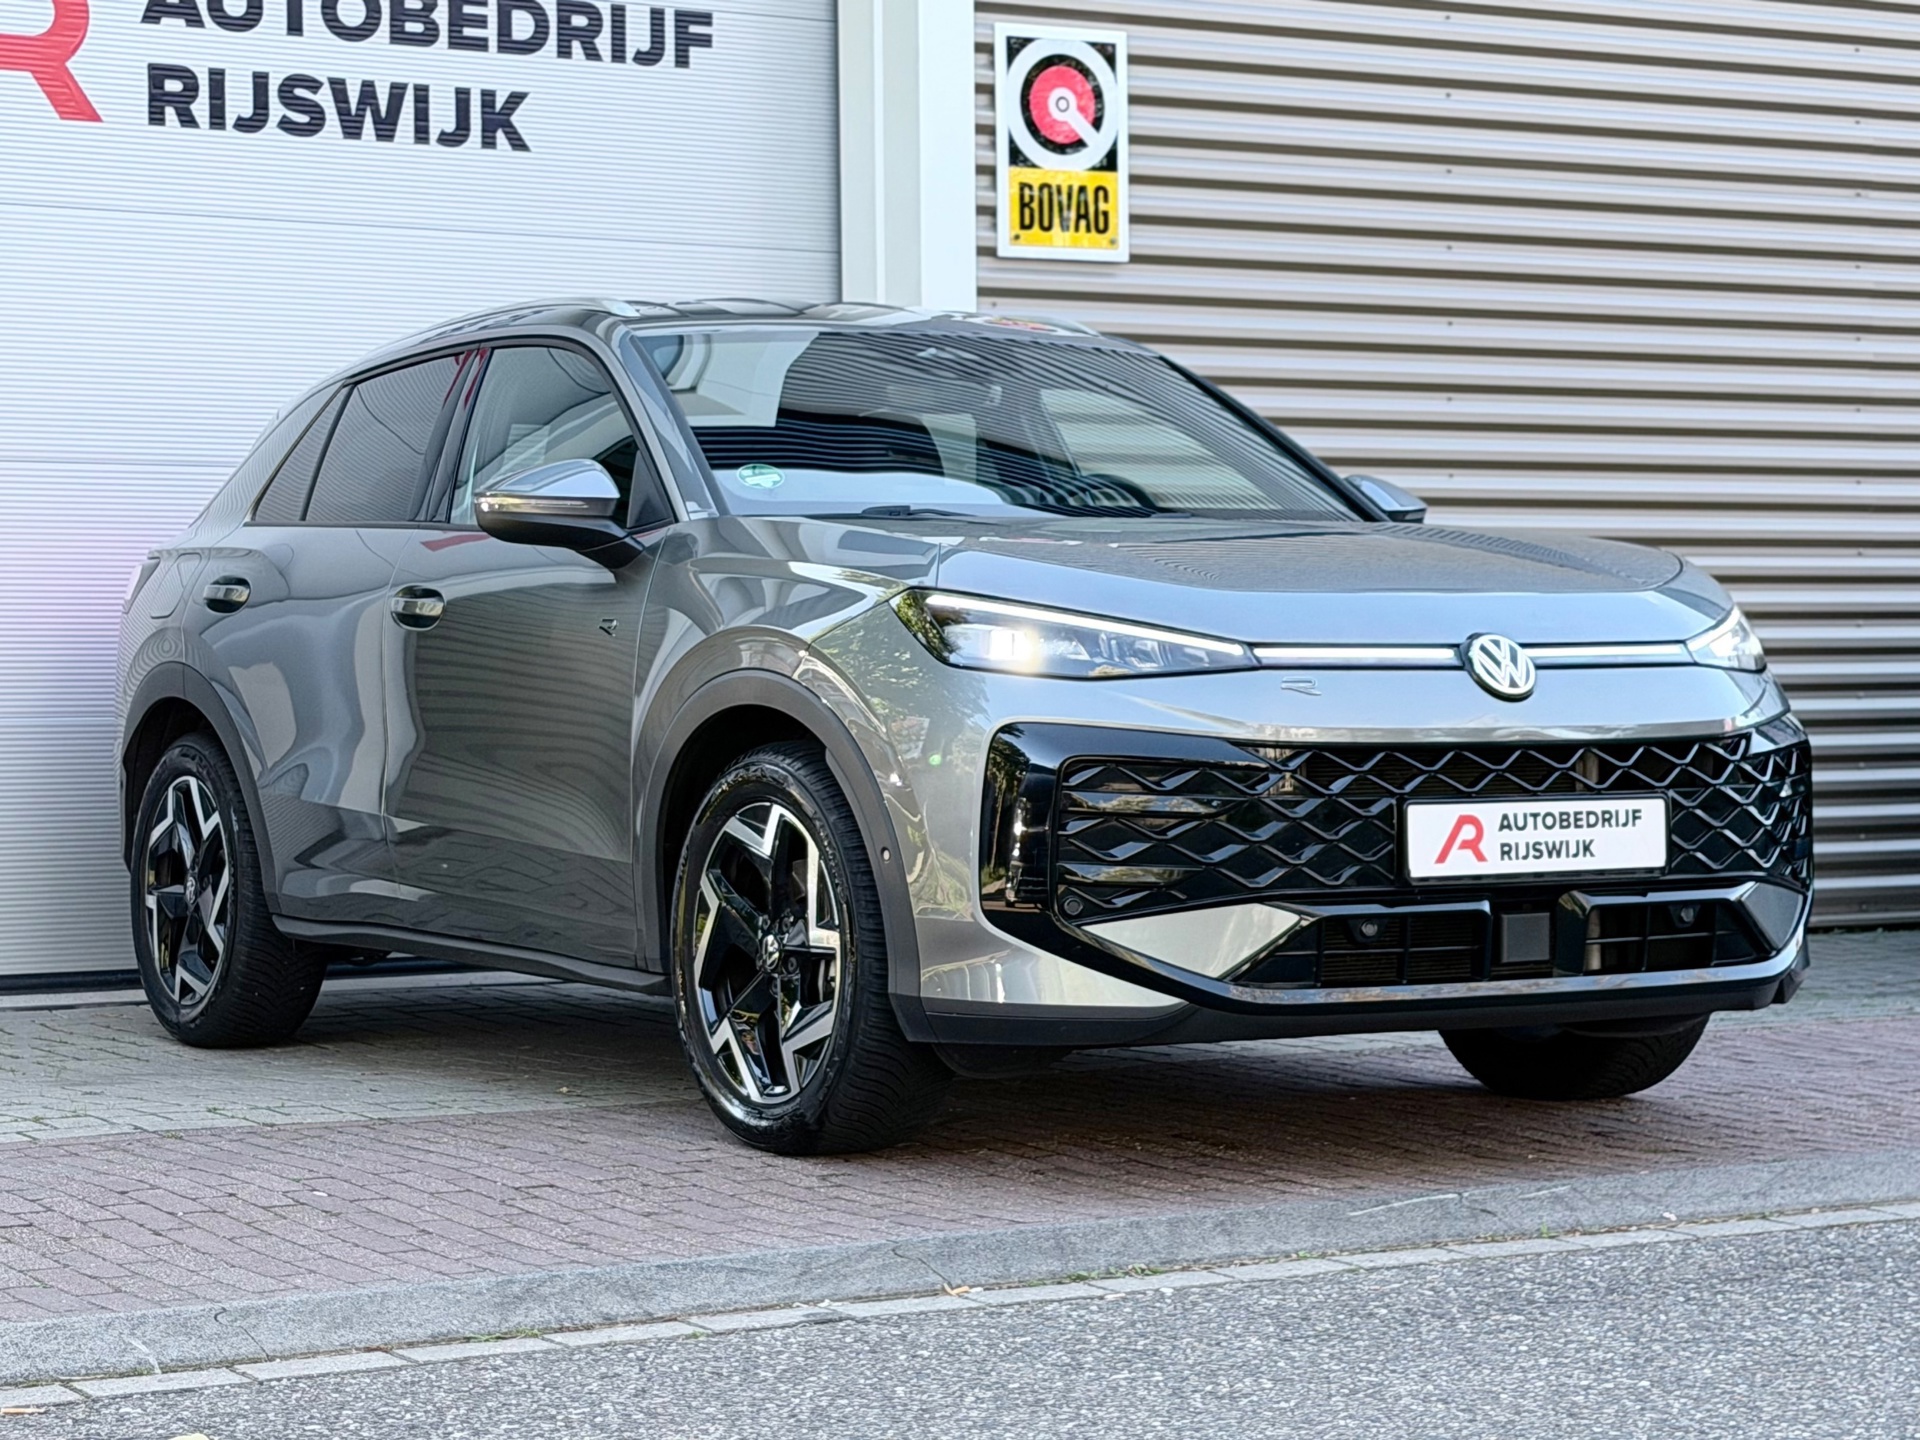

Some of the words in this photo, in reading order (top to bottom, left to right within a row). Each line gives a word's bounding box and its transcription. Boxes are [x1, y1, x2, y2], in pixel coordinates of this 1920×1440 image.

[147, 62, 532, 153] RIJSWIJK
[1018, 181, 1110, 235] BOVAG
[1498, 808, 1643, 832] AUTOBEDRIJF
[1499, 838, 1596, 862] RIJSWIJK
